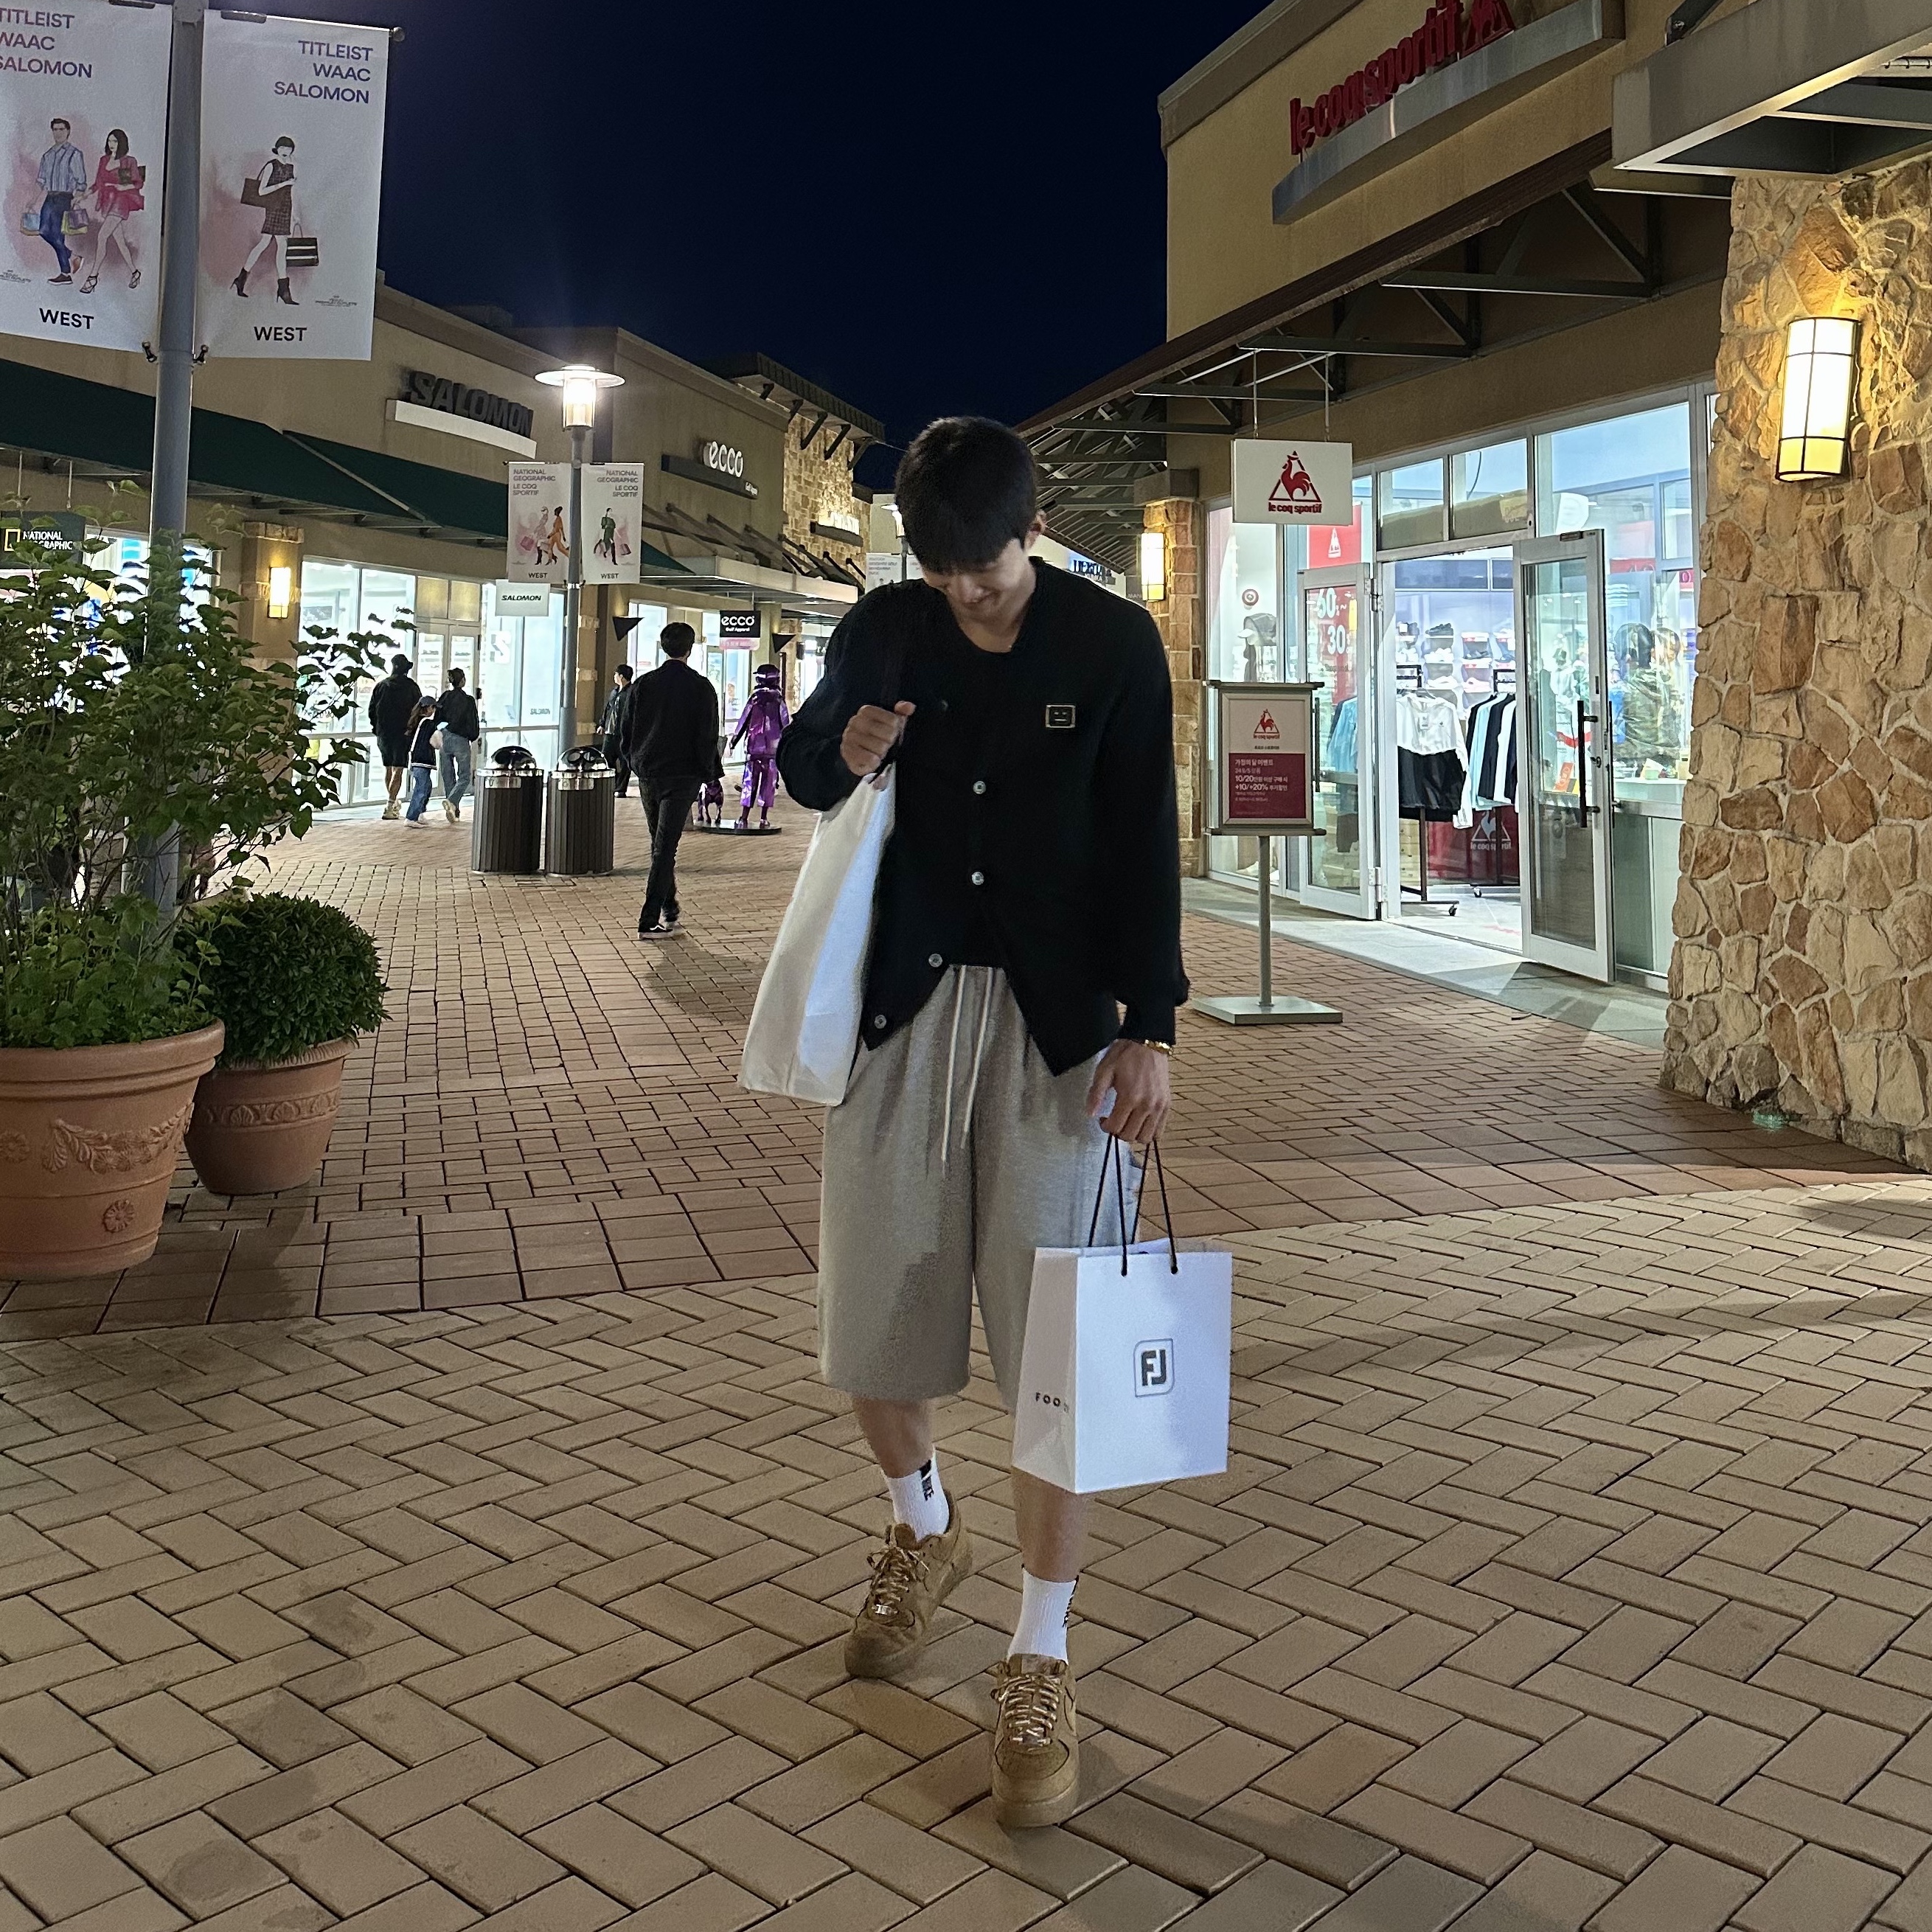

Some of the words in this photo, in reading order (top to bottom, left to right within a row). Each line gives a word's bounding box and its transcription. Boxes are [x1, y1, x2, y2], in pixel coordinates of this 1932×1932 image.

[298, 40, 374, 61] TITLEIST
[313, 63, 371, 82] WAAC
[274, 81, 369, 104] SALOMON
[39, 307, 94, 329] WEST
[254, 326, 307, 341] WEST
[407, 370, 534, 439] SALOMON
[706, 441, 744, 478] ecco
[1268, 502, 1276, 512] le
[1277, 504, 1293, 514] coq
[1294, 504, 1322, 514] sportif
[23, 531, 63, 541] NATIONAL
[721, 616, 755, 626] ecco
[1142, 1349, 1167, 1386] FJ
